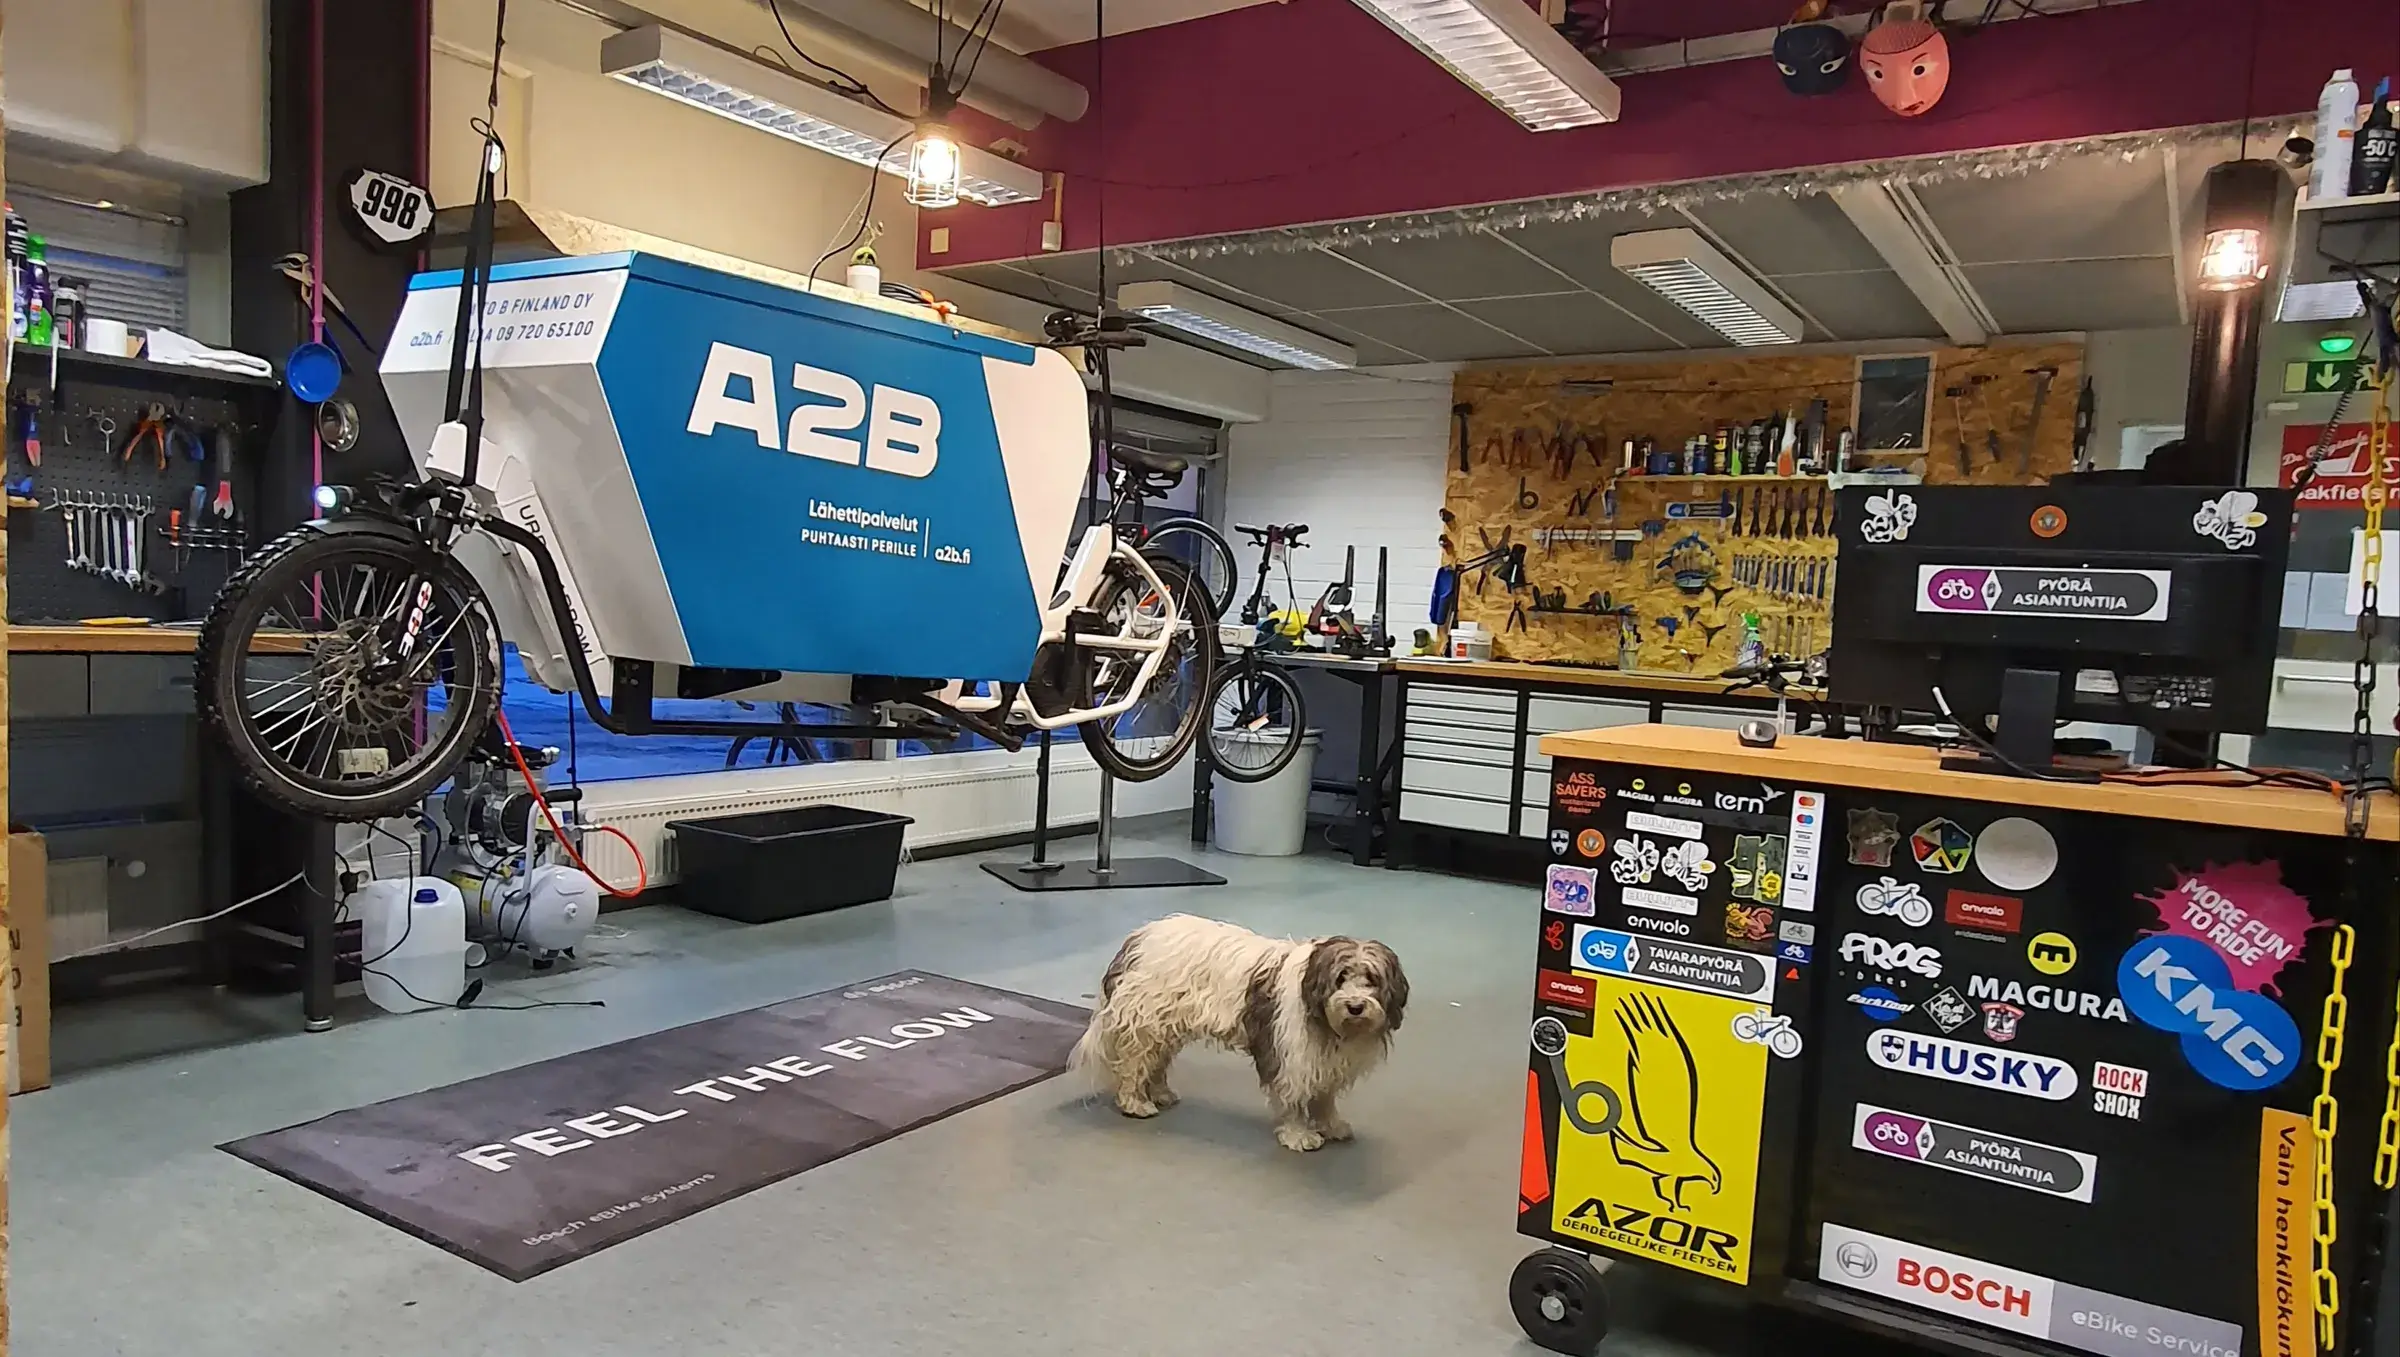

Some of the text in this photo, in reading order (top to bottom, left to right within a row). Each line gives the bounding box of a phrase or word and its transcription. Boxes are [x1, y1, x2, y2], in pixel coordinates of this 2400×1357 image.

[361, 178, 421, 230] 998
[500, 301, 508, 314] B
[511, 295, 570, 314] FINLAND
[573, 293, 594, 309] OY
[496, 325, 514, 341] 09
[517, 323, 545, 340] 720
[546, 320, 594, 338] 65100
[686, 341, 942, 478] A2B
[809, 499, 918, 533] Lähettipalvelut
[801, 529, 917, 557] PUHTAASTI PERILLE
[935, 545, 971, 564] a2b.fi
[2038, 577, 2093, 593] PYÖRÄ
[2012, 594, 2128, 611] ASIANTUNTIJA
[1556, 783, 1607, 799] SAVERS
[1569, 772, 1596, 785] ASS
[1663, 795, 1703, 807] MAGURA
[1715, 791, 1764, 814] tern
[1628, 915, 1690, 936] enviolo
[2180, 877, 2294, 960] MORE FUN
[2181, 901, 2264, 967] TO RIDE
[1649, 946, 1745, 973] TAVARAPYÖRÄ
[1838, 932, 1943, 978] FROG
[1648, 961, 1742, 987] ASIANTUNTIJA
[1967, 975, 2128, 1022] MAGURA
[2133, 947, 2285, 1077] KMC
[1908, 1040, 2063, 1092] HUSKY
[2097, 1066, 2142, 1093] ROCK
[457, 1006, 994, 1172] FEEL THE FLOW
[2093, 1090, 2141, 1120] SHOX
[1970, 1138, 2022, 1161] PYÖRÄ
[2275, 1126, 2297, 1187] Vain
[1944, 1149, 2055, 1184] ASIANTUNTIJA
[1568, 1197, 1739, 1262] AZOR
[1672, 1248, 1738, 1274] FIETSEN
[1896, 1257, 2031, 1317] BOSCH
[2071, 1311, 2139, 1339] eBike
